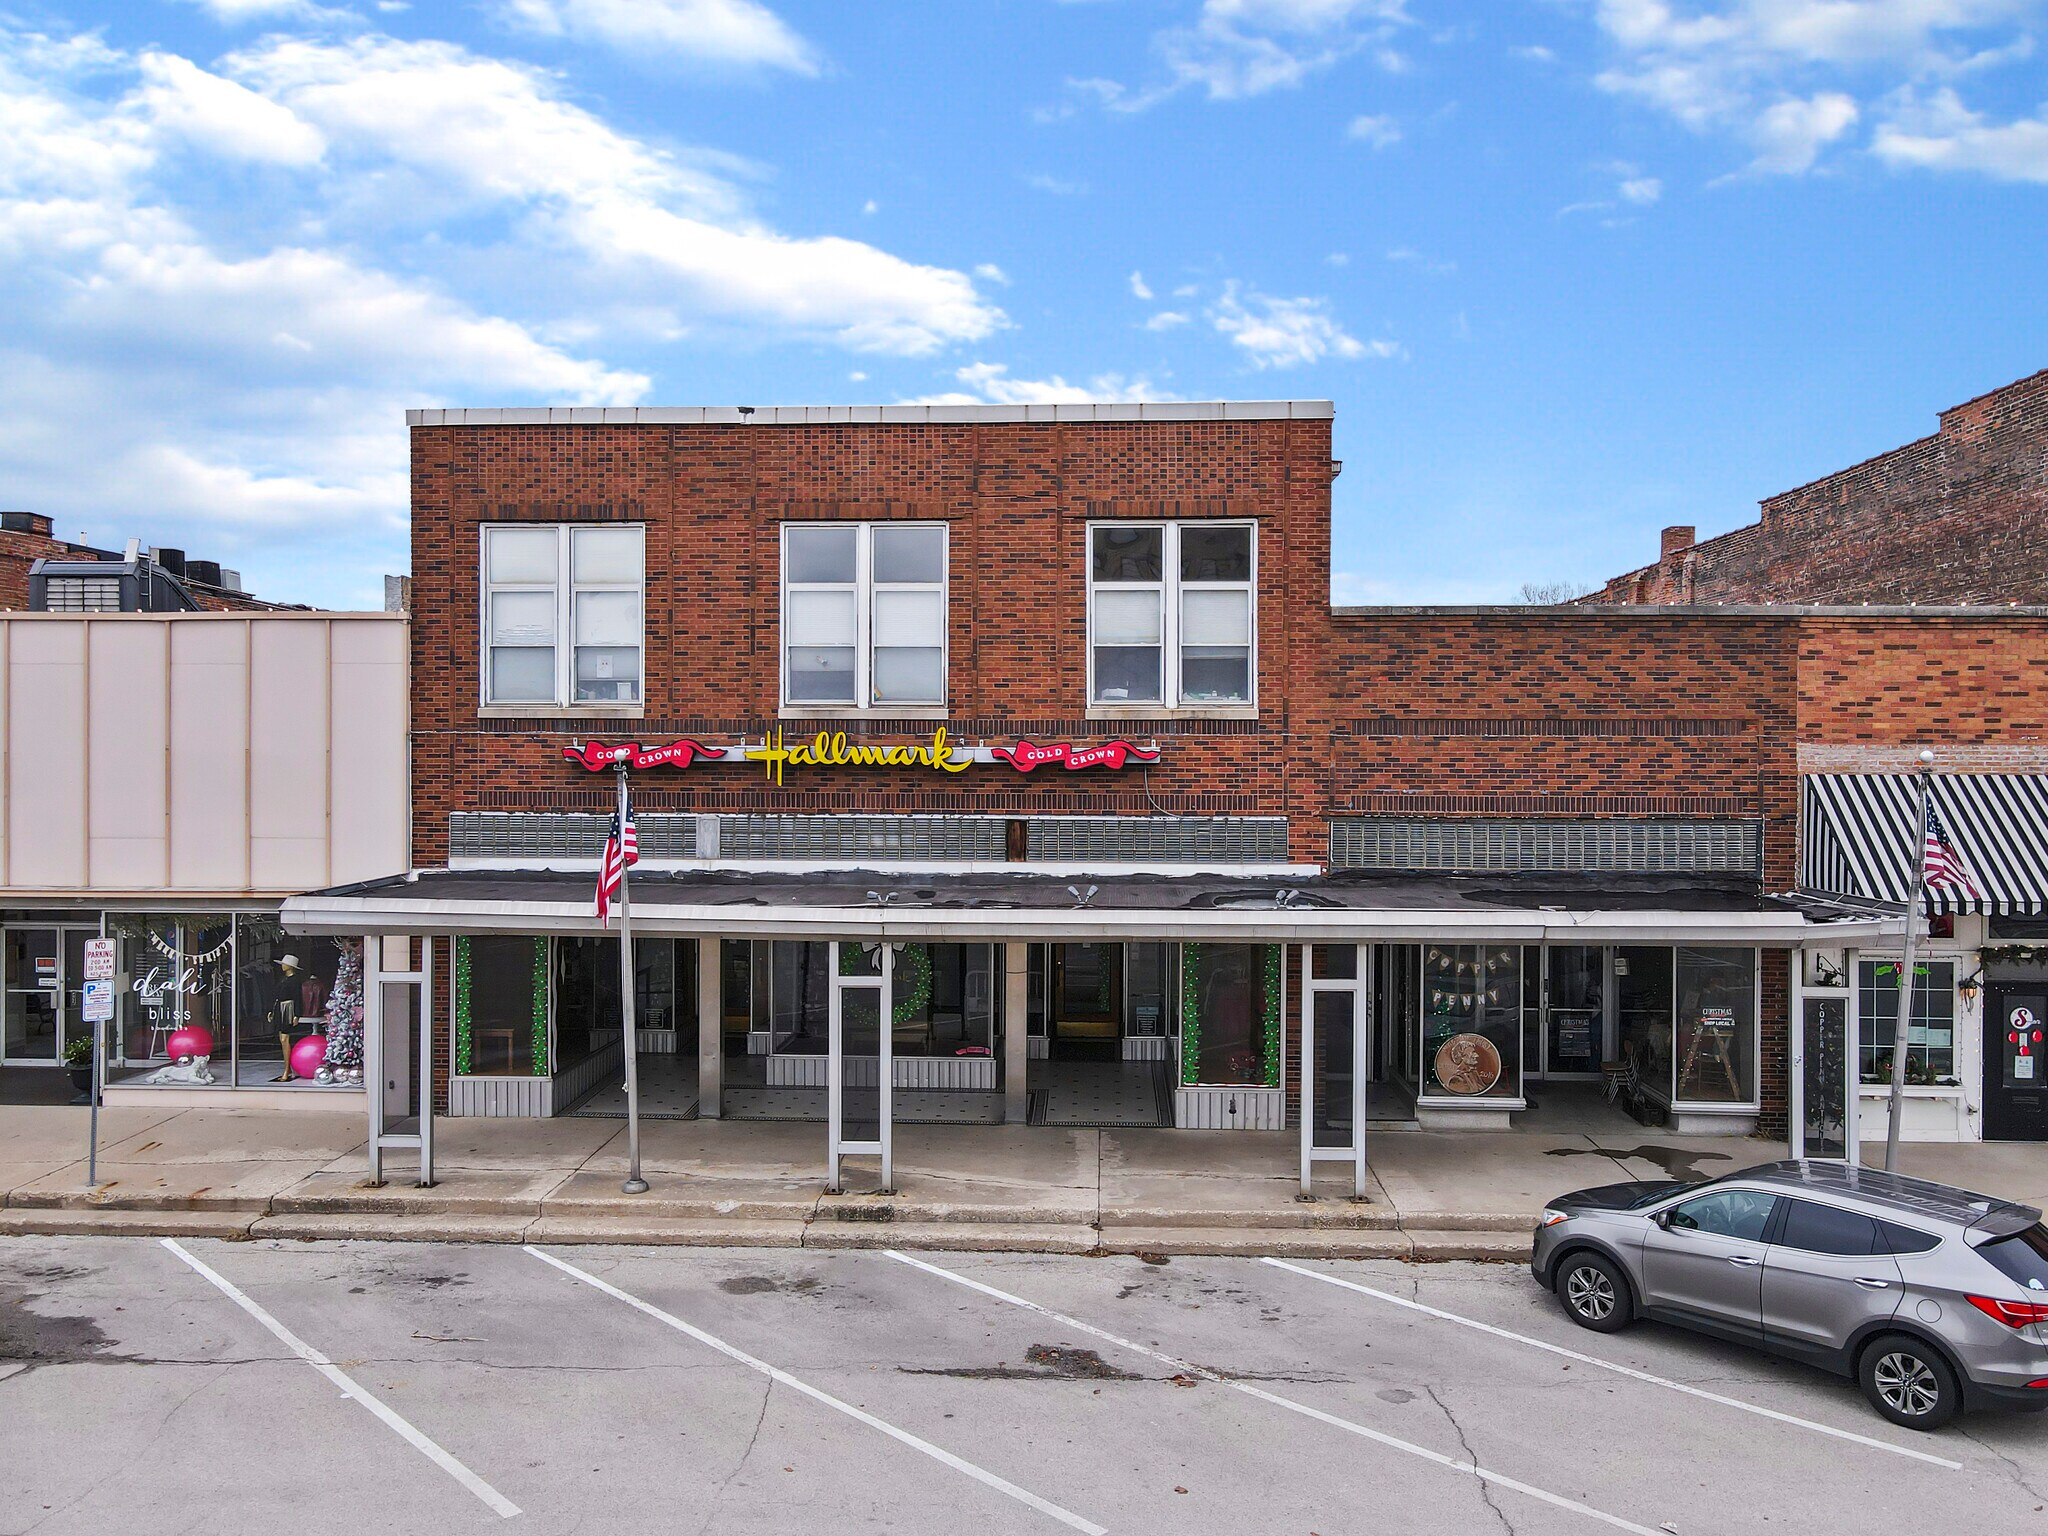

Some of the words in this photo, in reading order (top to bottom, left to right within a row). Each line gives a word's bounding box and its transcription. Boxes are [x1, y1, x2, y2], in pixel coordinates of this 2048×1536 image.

[597, 748, 630, 759] GOD
[639, 749, 682, 764] CROWN
[744, 724, 974, 786] Hallmark
[1027, 749, 1063, 760] GOLD
[1071, 750, 1115, 765] CROWN
[88, 950, 113, 958] PARKING
[1429, 950, 1511, 973] COPPER
[87, 985, 96, 994] P
[1433, 990, 1497, 1006] PENNY
[149, 1007, 191, 1020] bliss
